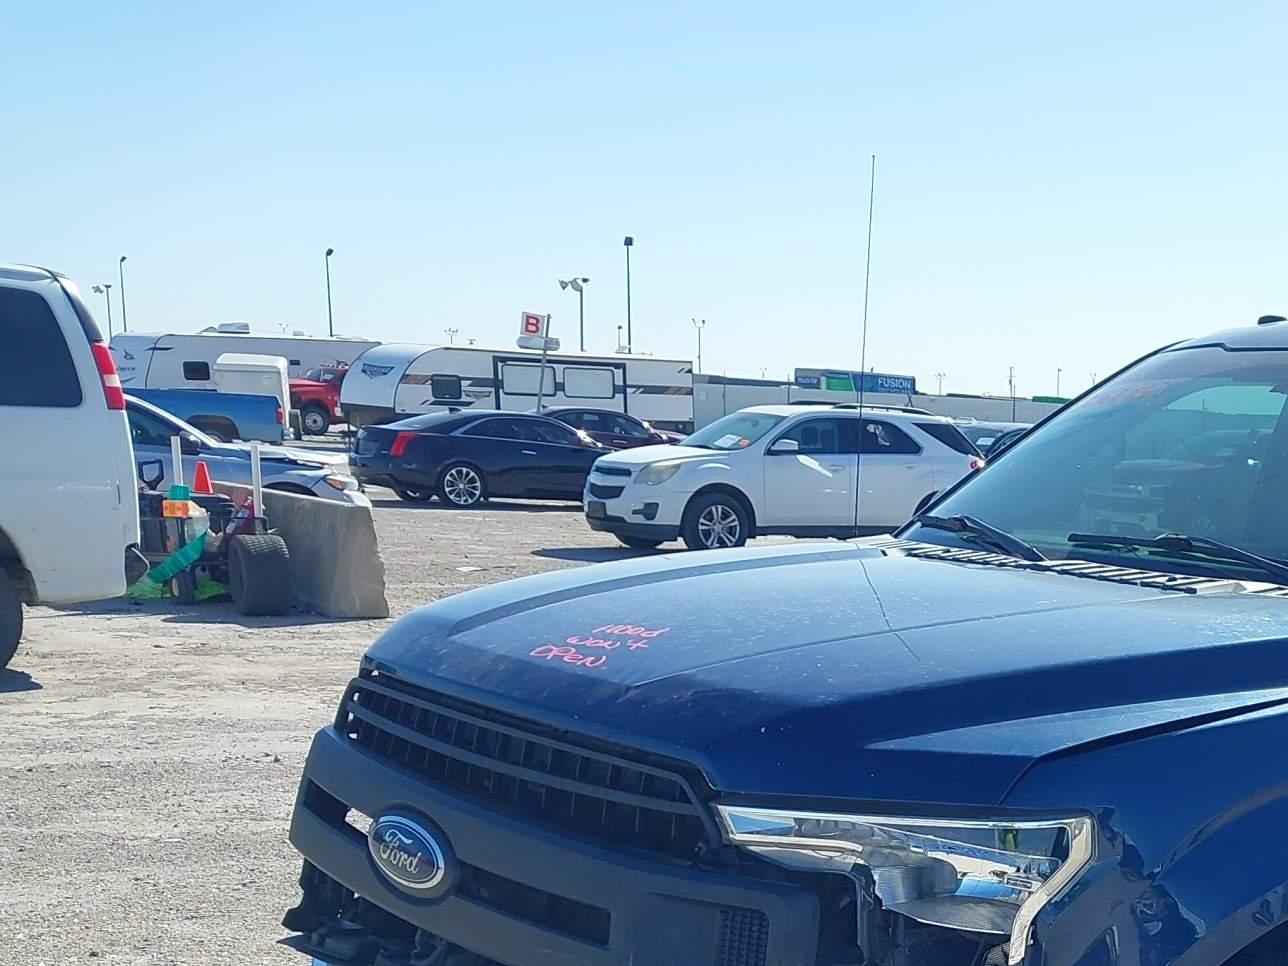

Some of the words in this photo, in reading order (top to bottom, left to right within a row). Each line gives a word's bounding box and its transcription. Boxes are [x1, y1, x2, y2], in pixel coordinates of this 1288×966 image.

[525, 315, 541, 334] B
[877, 377, 912, 389] FUSION
[379, 828, 423, 875] Ford
